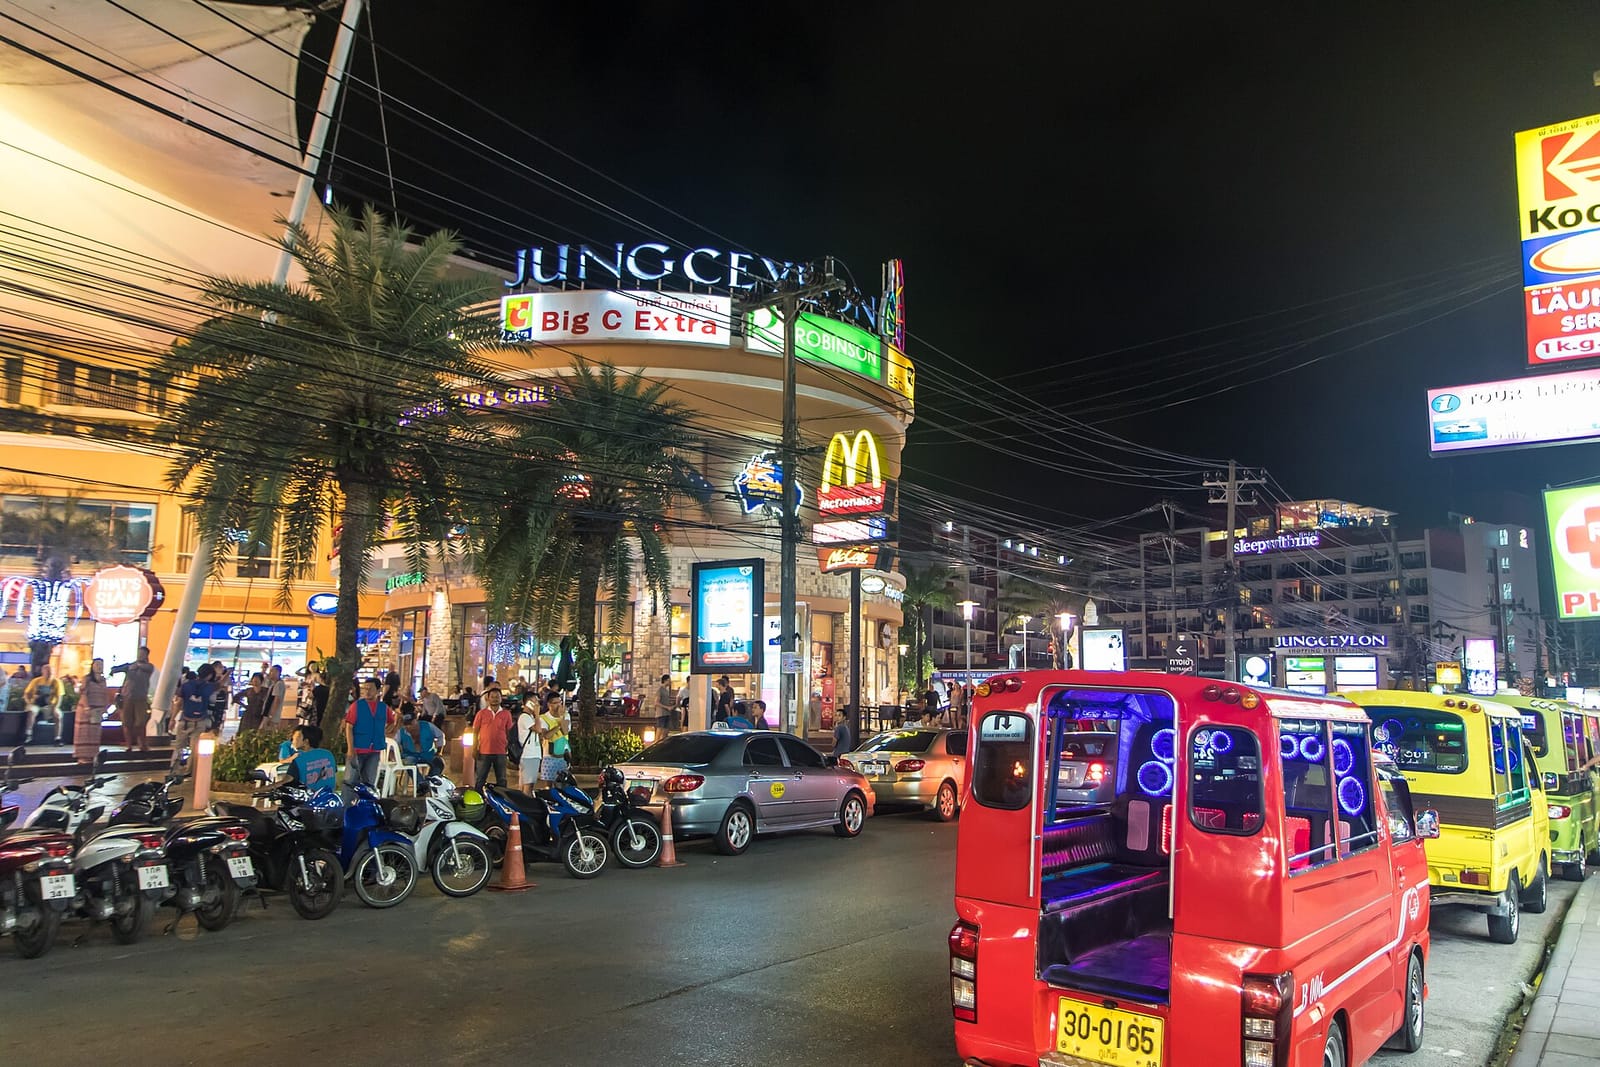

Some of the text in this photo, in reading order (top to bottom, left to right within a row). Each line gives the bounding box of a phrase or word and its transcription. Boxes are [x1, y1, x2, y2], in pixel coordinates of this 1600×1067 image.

[541, 309, 717, 335] Big C Extra
[794, 327, 877, 367] ROBINSON
[821, 496, 882, 510] McDonald's
[97, 577, 142, 591] THAT'S
[95, 591, 140, 607] SIAM
[1275, 635, 1385, 648] JUNGCEYLON
[1064, 1009, 1155, 1055] 30-0165
